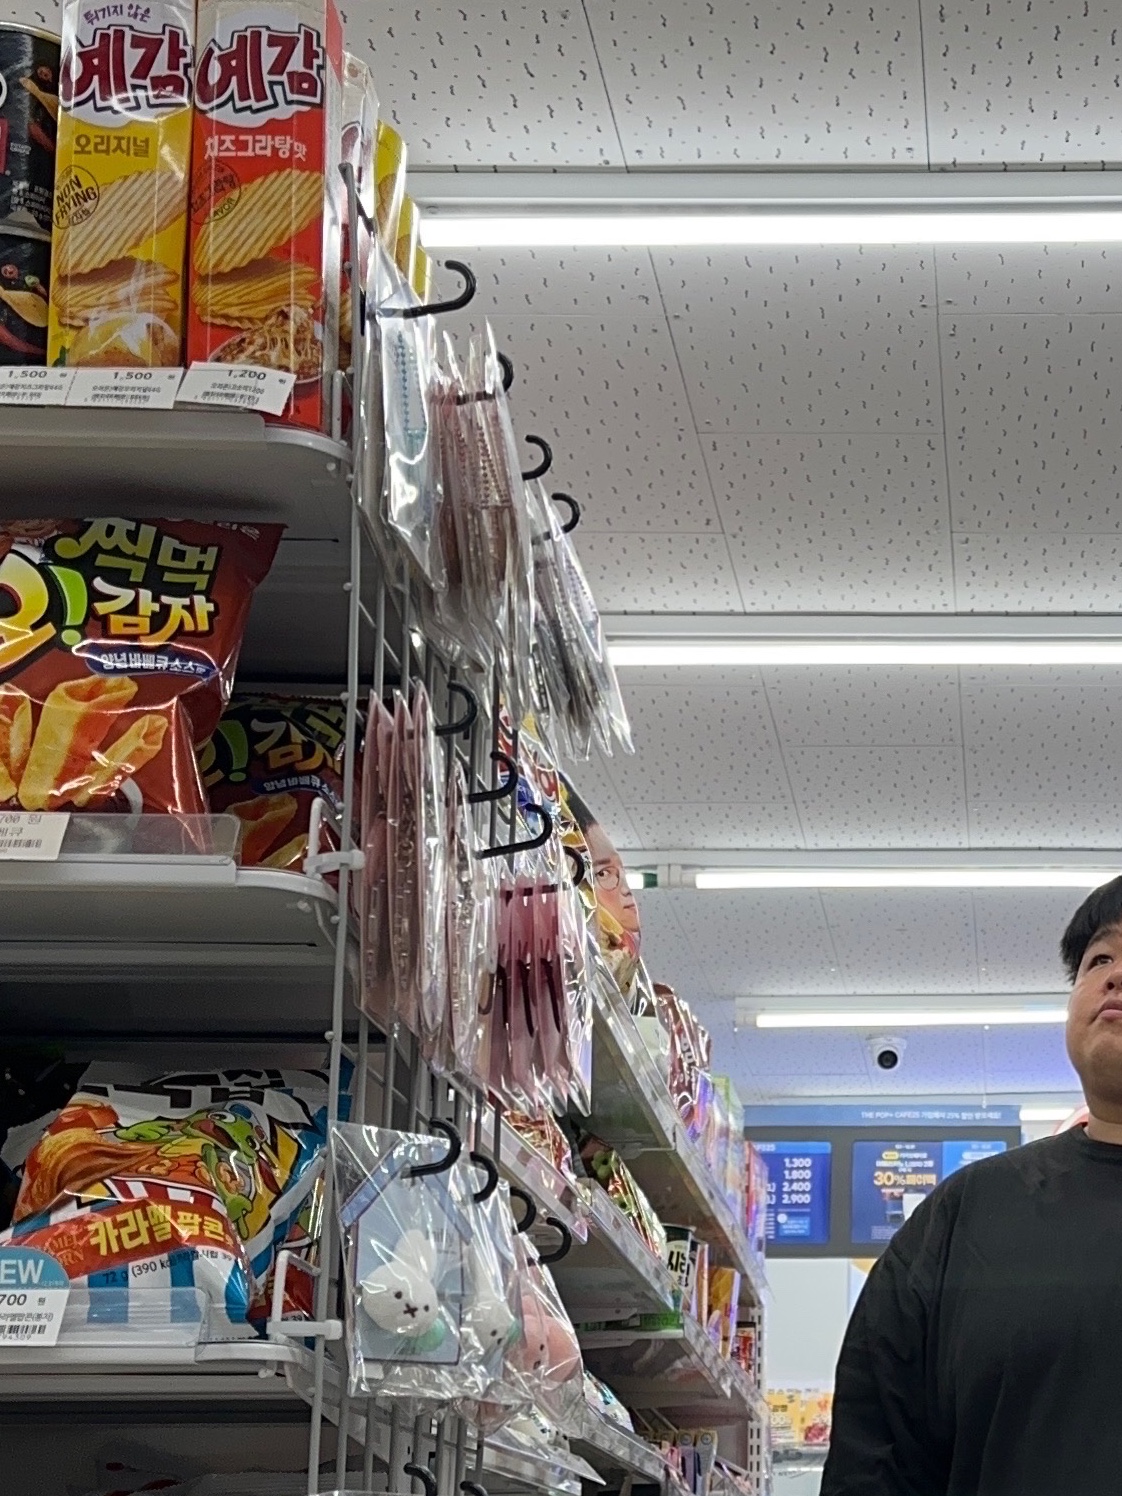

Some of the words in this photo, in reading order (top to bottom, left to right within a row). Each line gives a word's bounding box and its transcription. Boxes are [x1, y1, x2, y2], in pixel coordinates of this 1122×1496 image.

[83, 4, 123, 25] 튀기지
[61, 26, 190, 106] 예감
[198, 27, 324, 108] 예감
[74, 134, 150, 158] 오리지널
[204, 134, 308, 161] 치즈그라탕맛
[55, 175, 83, 207] NON
[54, 187, 98, 226] FRYING
[113, 371, 153, 381] 1,500
[227, 368, 267, 381] 1,200
[92, 577, 214, 645] 감자
[88, 1205, 171, 1256] 카라멜
[0, 1260, 45, 1284] EW
[103, 1270, 118, 1283] 72
[131, 1262, 157, 1279] (390
